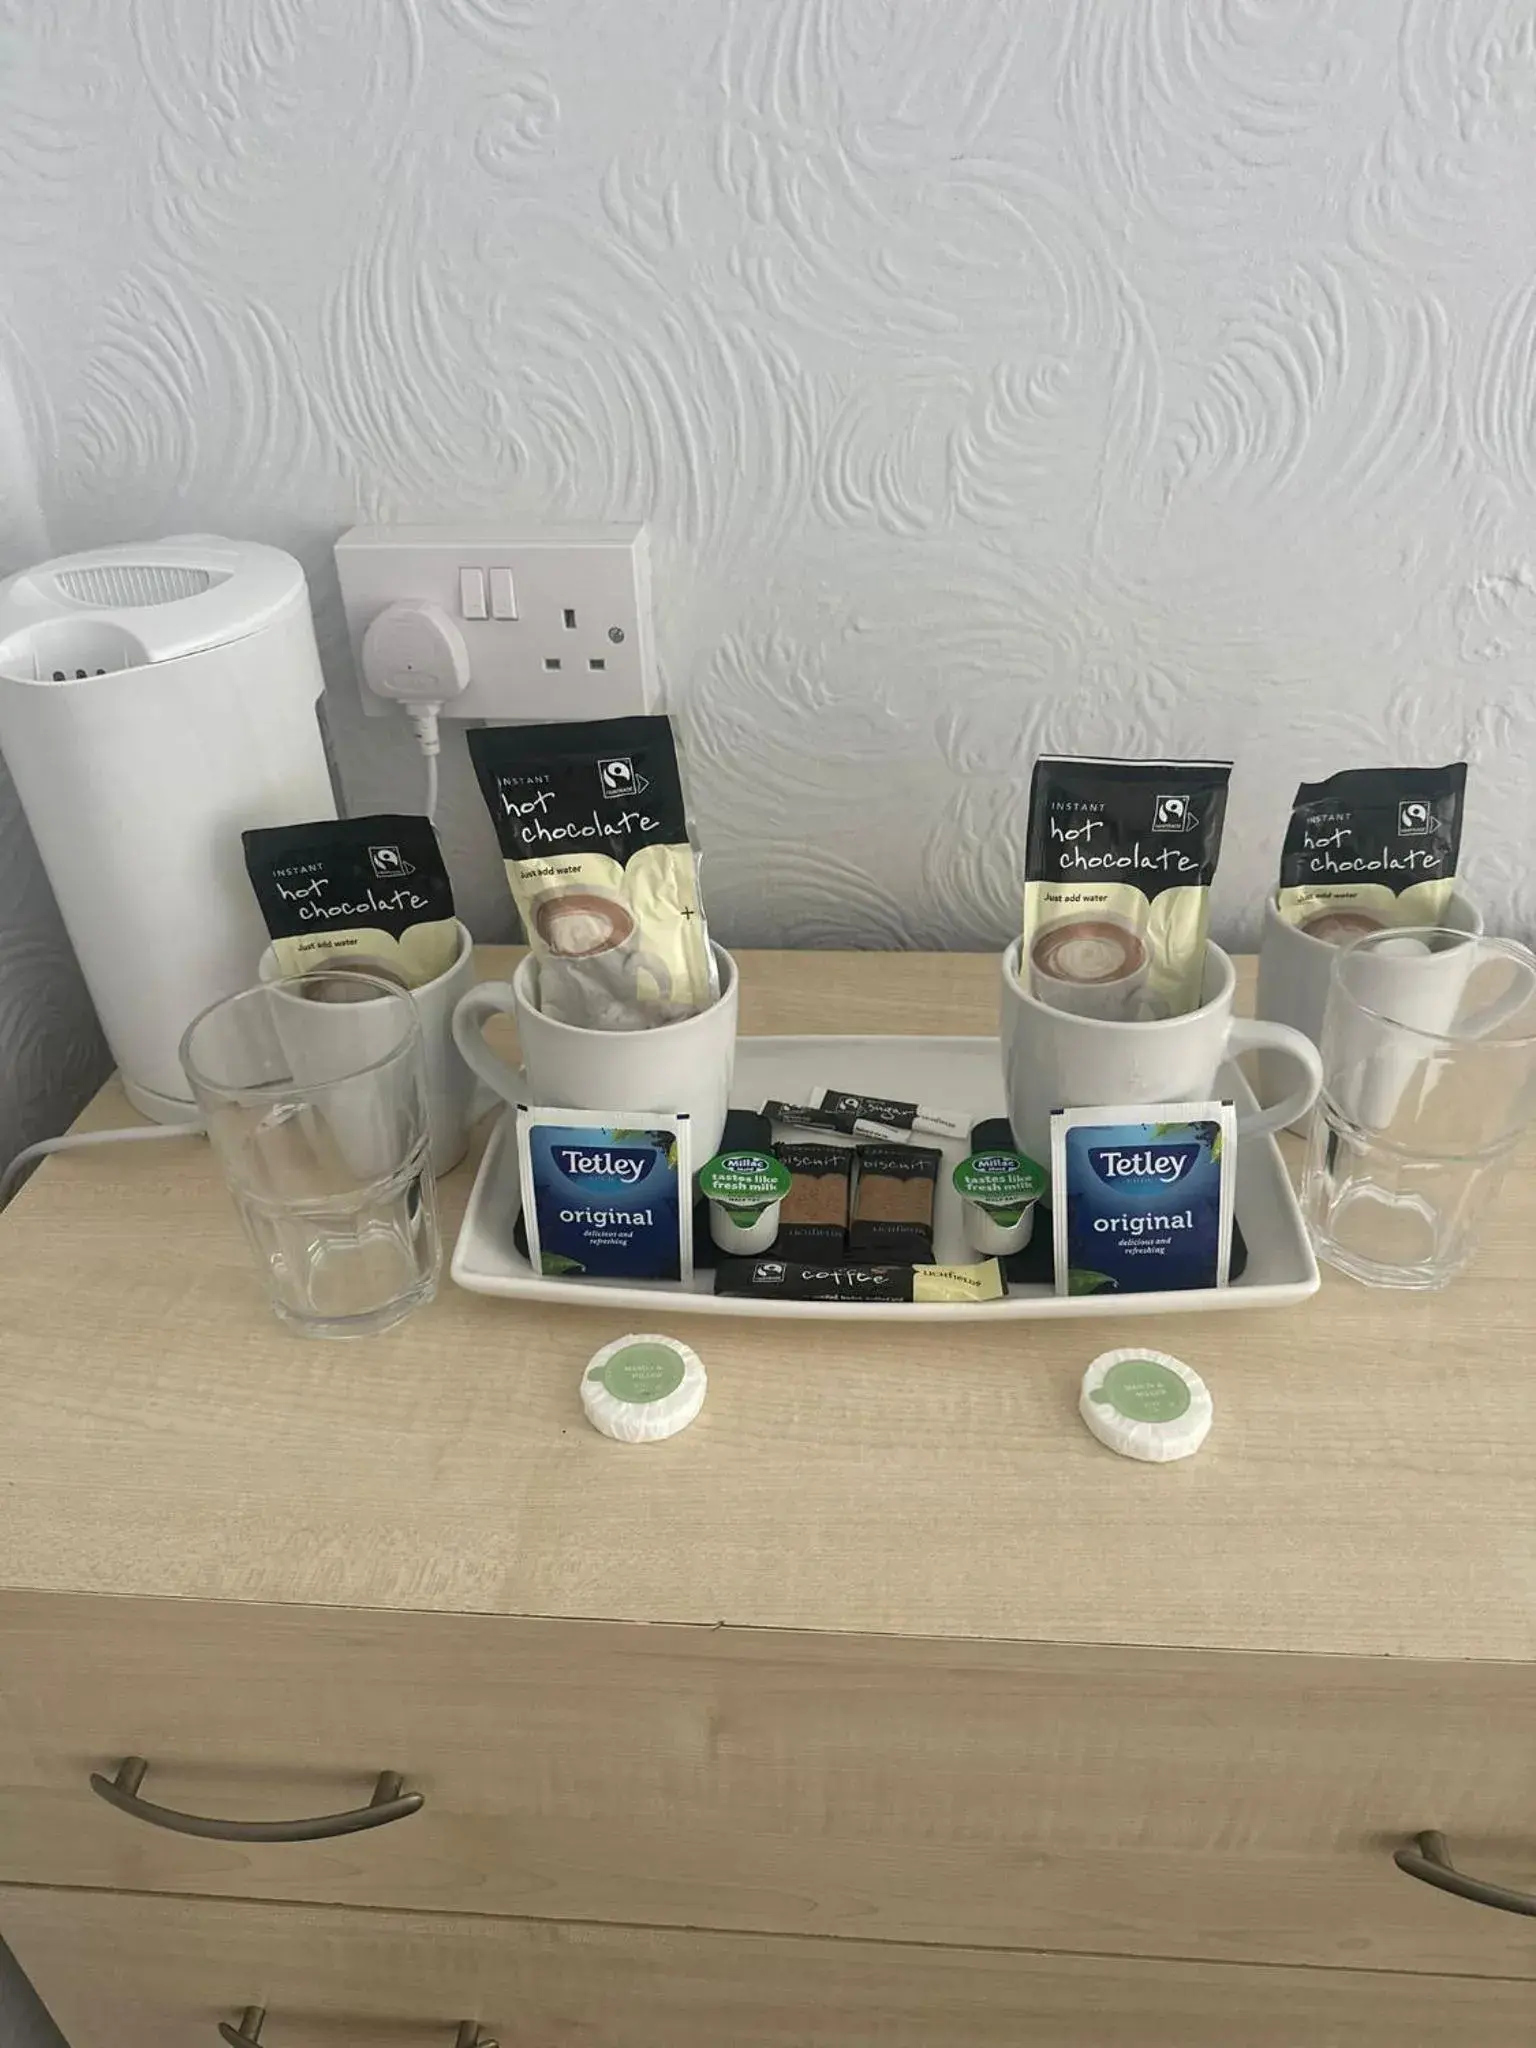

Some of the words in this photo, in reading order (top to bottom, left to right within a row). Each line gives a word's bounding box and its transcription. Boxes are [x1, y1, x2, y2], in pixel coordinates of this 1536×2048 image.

[498, 774, 551, 787] INSTANT
[501, 790, 556, 818] hot
[1050, 801, 1107, 812] INSTANT
[1306, 812, 1352, 825] INSTANT
[521, 809, 660, 844] chocolate
[1050, 816, 1104, 842] hot
[1303, 828, 1352, 850] hot
[1059, 841, 1199, 872] chocolate
[1309, 845, 1441, 874] chocolate
[272, 862, 325, 878] INSTANT
[537, 867, 555, 876] add
[556, 864, 582, 875] water
[276, 878, 329, 901] hot
[299, 887, 429, 920] chocolate
[1043, 893, 1062, 903] Just
[1064, 893, 1081, 903] add
[1083, 893, 1108, 903] water
[298, 942, 315, 952] Just
[317, 940, 333, 949] add
[335, 938, 358, 948] water
[561, 1150, 646, 1183] Tetley
[727, 1159, 764, 1168] Millac
[978, 1159, 1016, 1168] Millac
[1099, 1151, 1188, 1183] Tetley
[712, 1174, 753, 1183] tastes
[755, 1175, 779, 1183] like
[964, 1175, 1006, 1184] tastes
[1008, 1174, 1033, 1182] like
[712, 1180, 747, 1190] fresh
[749, 1183, 777, 1191] milk
[966, 1182, 1002, 1191] fresh
[1004, 1182, 1033, 1190] milk
[559, 1207, 654, 1228] original
[1093, 1210, 1194, 1236] original
[583, 1229, 617, 1238] delicious
[589, 1238, 628, 1247] refreshing
[1117, 1238, 1154, 1247] delicious
[1155, 1237, 1172, 1245] and
[1124, 1246, 1165, 1255] refreshing
[801, 1266, 890, 1287] coffee
